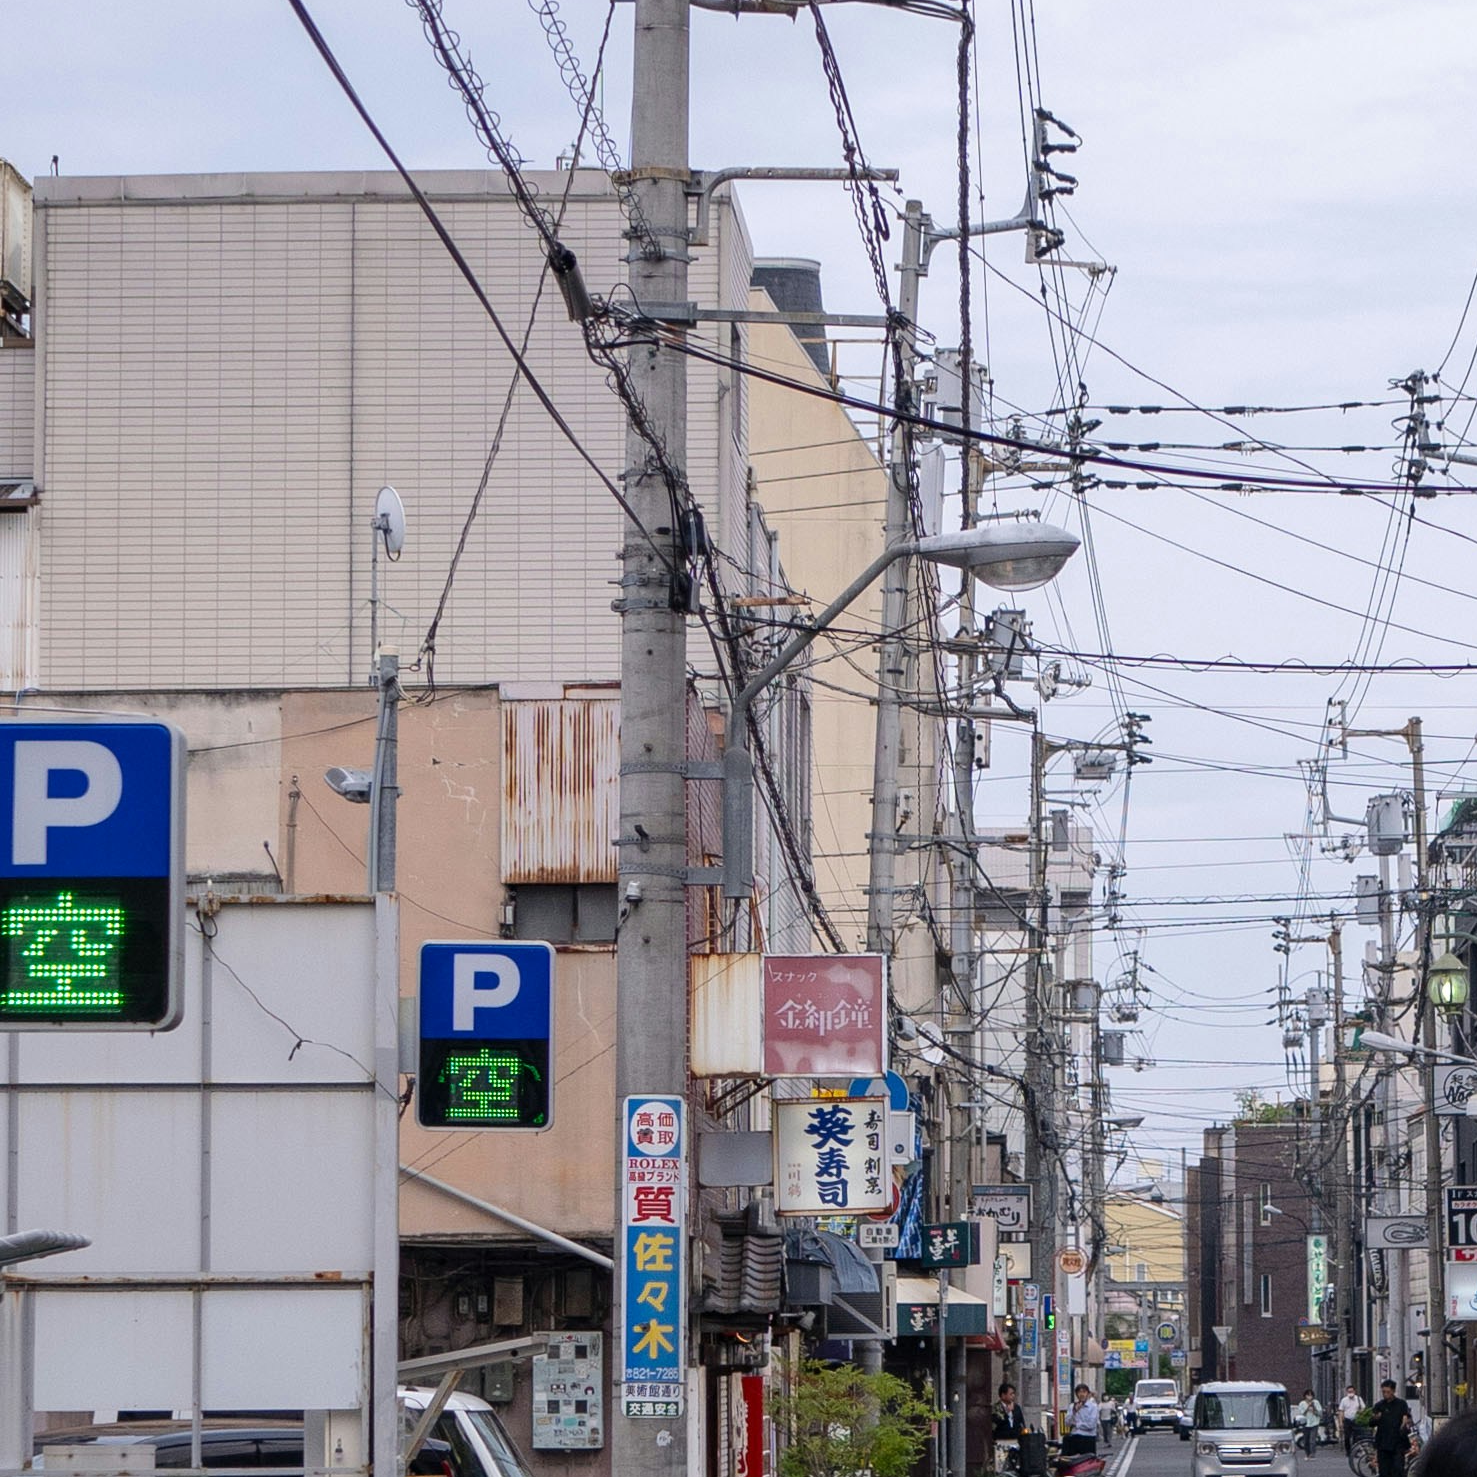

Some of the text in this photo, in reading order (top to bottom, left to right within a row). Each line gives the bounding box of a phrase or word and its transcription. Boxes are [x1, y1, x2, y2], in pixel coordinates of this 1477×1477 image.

[12, 740, 122, 864] P
[0, 892, 124, 1007] 空
[772, 972, 817, 982] スナック
[453, 954, 520, 1031] P
[444, 1048, 520, 1120] 空
[637, 1113, 674, 1127] 高価
[629, 1159, 679, 1170] ROLEX
[629, 1171, 679, 1182] 高級ブランド
[632, 1232, 675, 1359] 佐々木
[625, 1384, 680, 1398] 美術館通り
[629, 1403, 677, 1416] 交通安全
